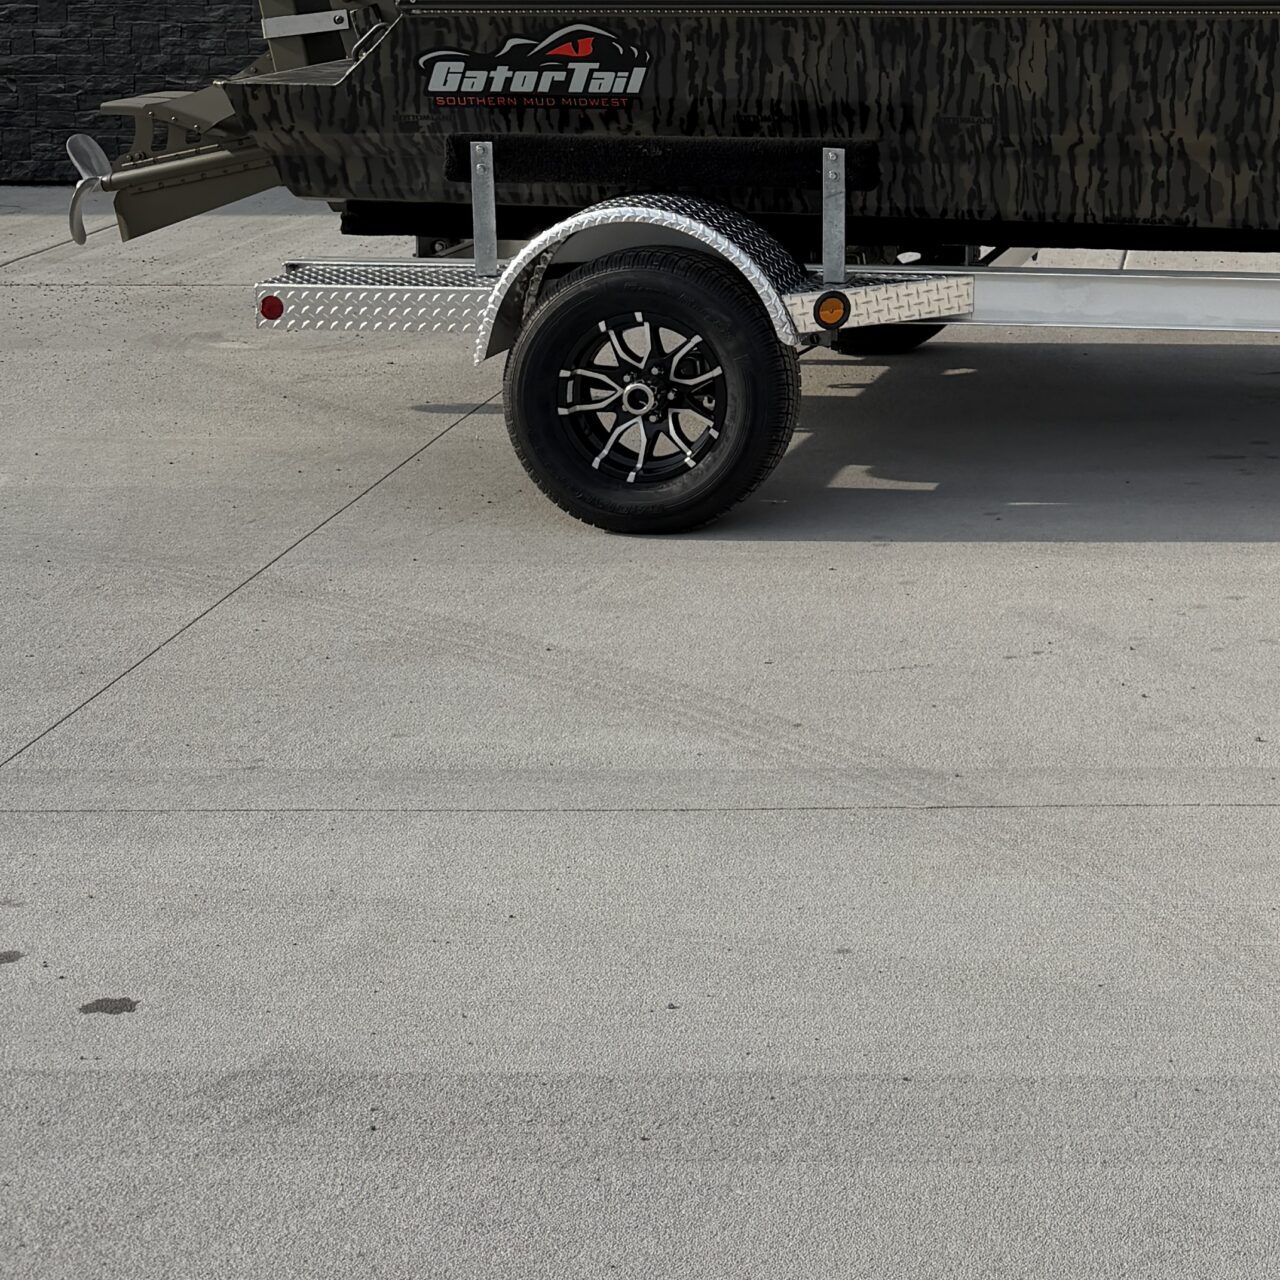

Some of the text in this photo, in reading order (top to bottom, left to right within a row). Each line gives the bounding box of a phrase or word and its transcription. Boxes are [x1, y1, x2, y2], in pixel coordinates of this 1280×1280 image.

[428, 61, 647, 94] GatorTail
[436, 96, 629, 108] SOUTHERN MUD MIDWEST
